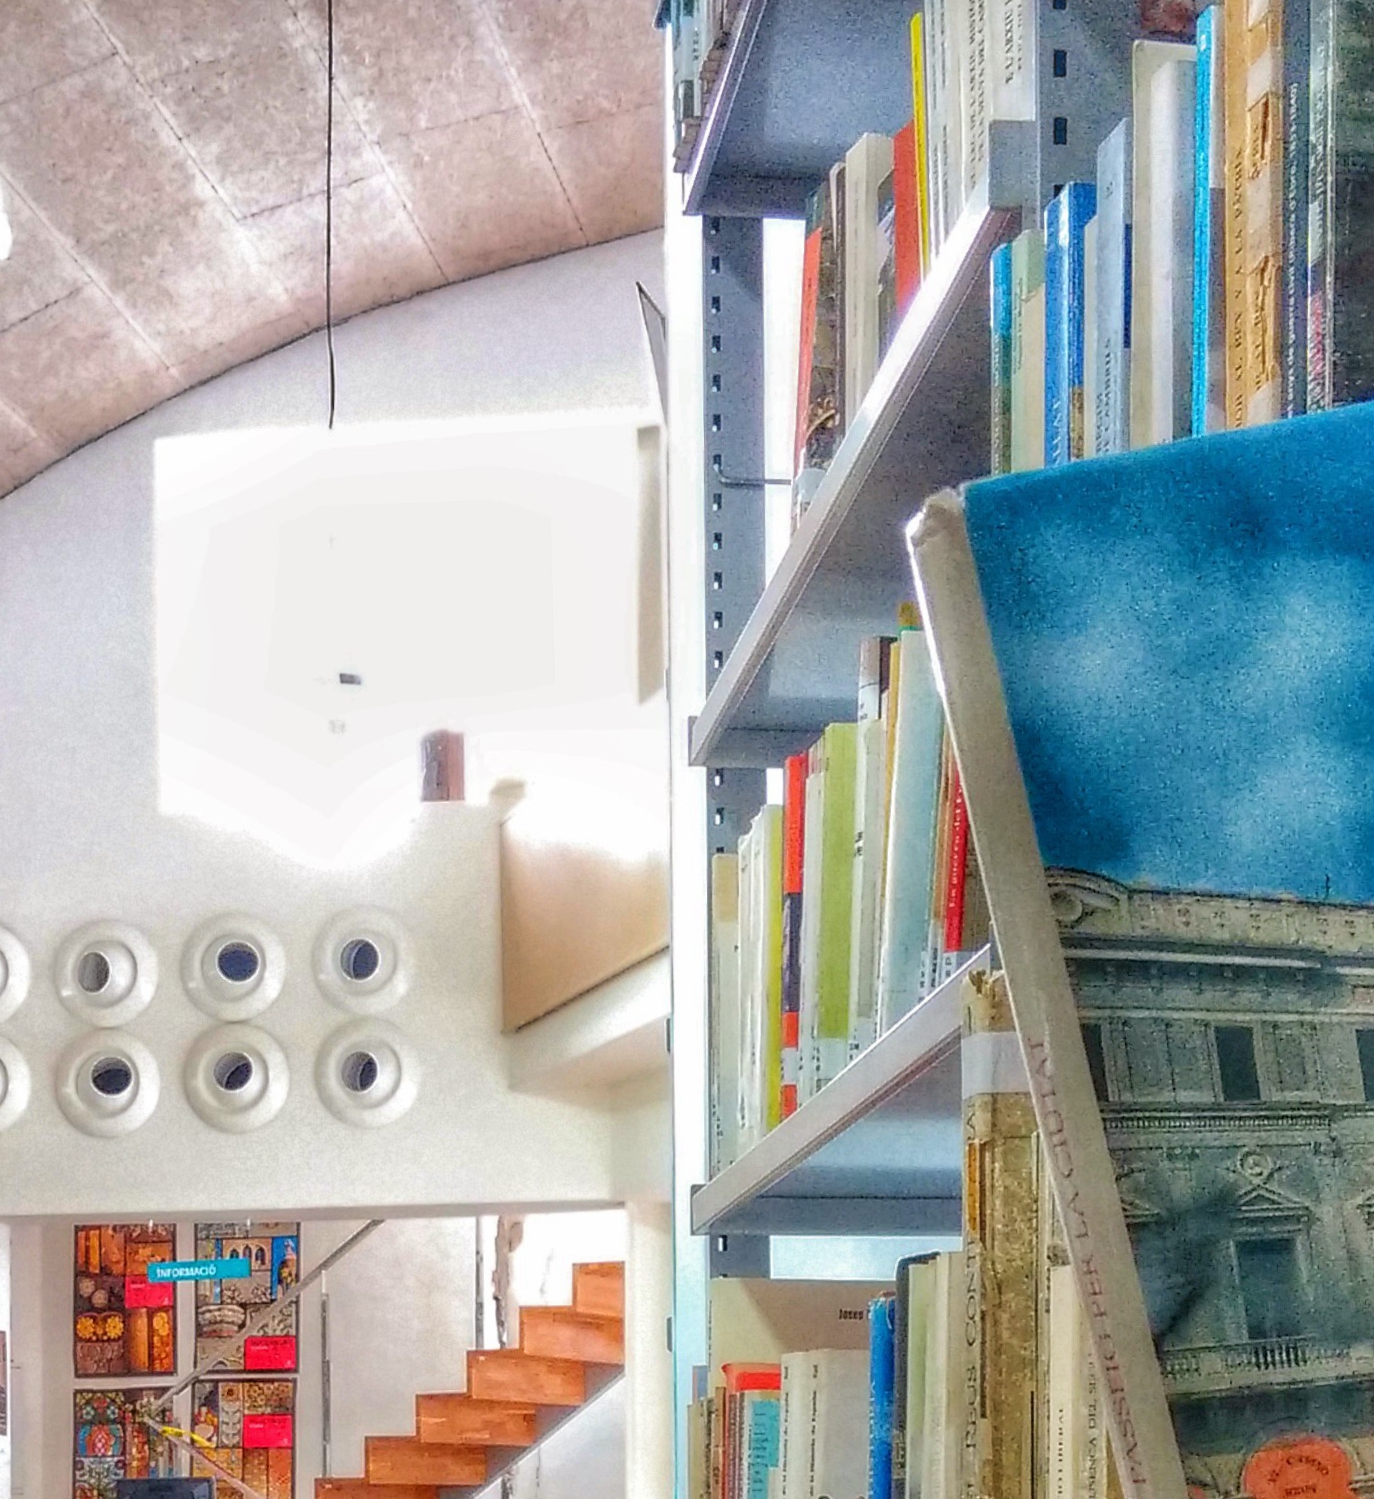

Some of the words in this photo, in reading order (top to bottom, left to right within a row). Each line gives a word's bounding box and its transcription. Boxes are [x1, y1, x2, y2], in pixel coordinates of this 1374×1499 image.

[1027, 1037, 1074, 1180] CIUTAT
[1066, 1191, 1089, 1239] LA
[1081, 1252, 1109, 1320] PER
[964, 1364, 979, 1449] REUS
[1087, 1399, 1099, 1430] DEL
[1095, 1332, 1147, 1487] PASSEIG
